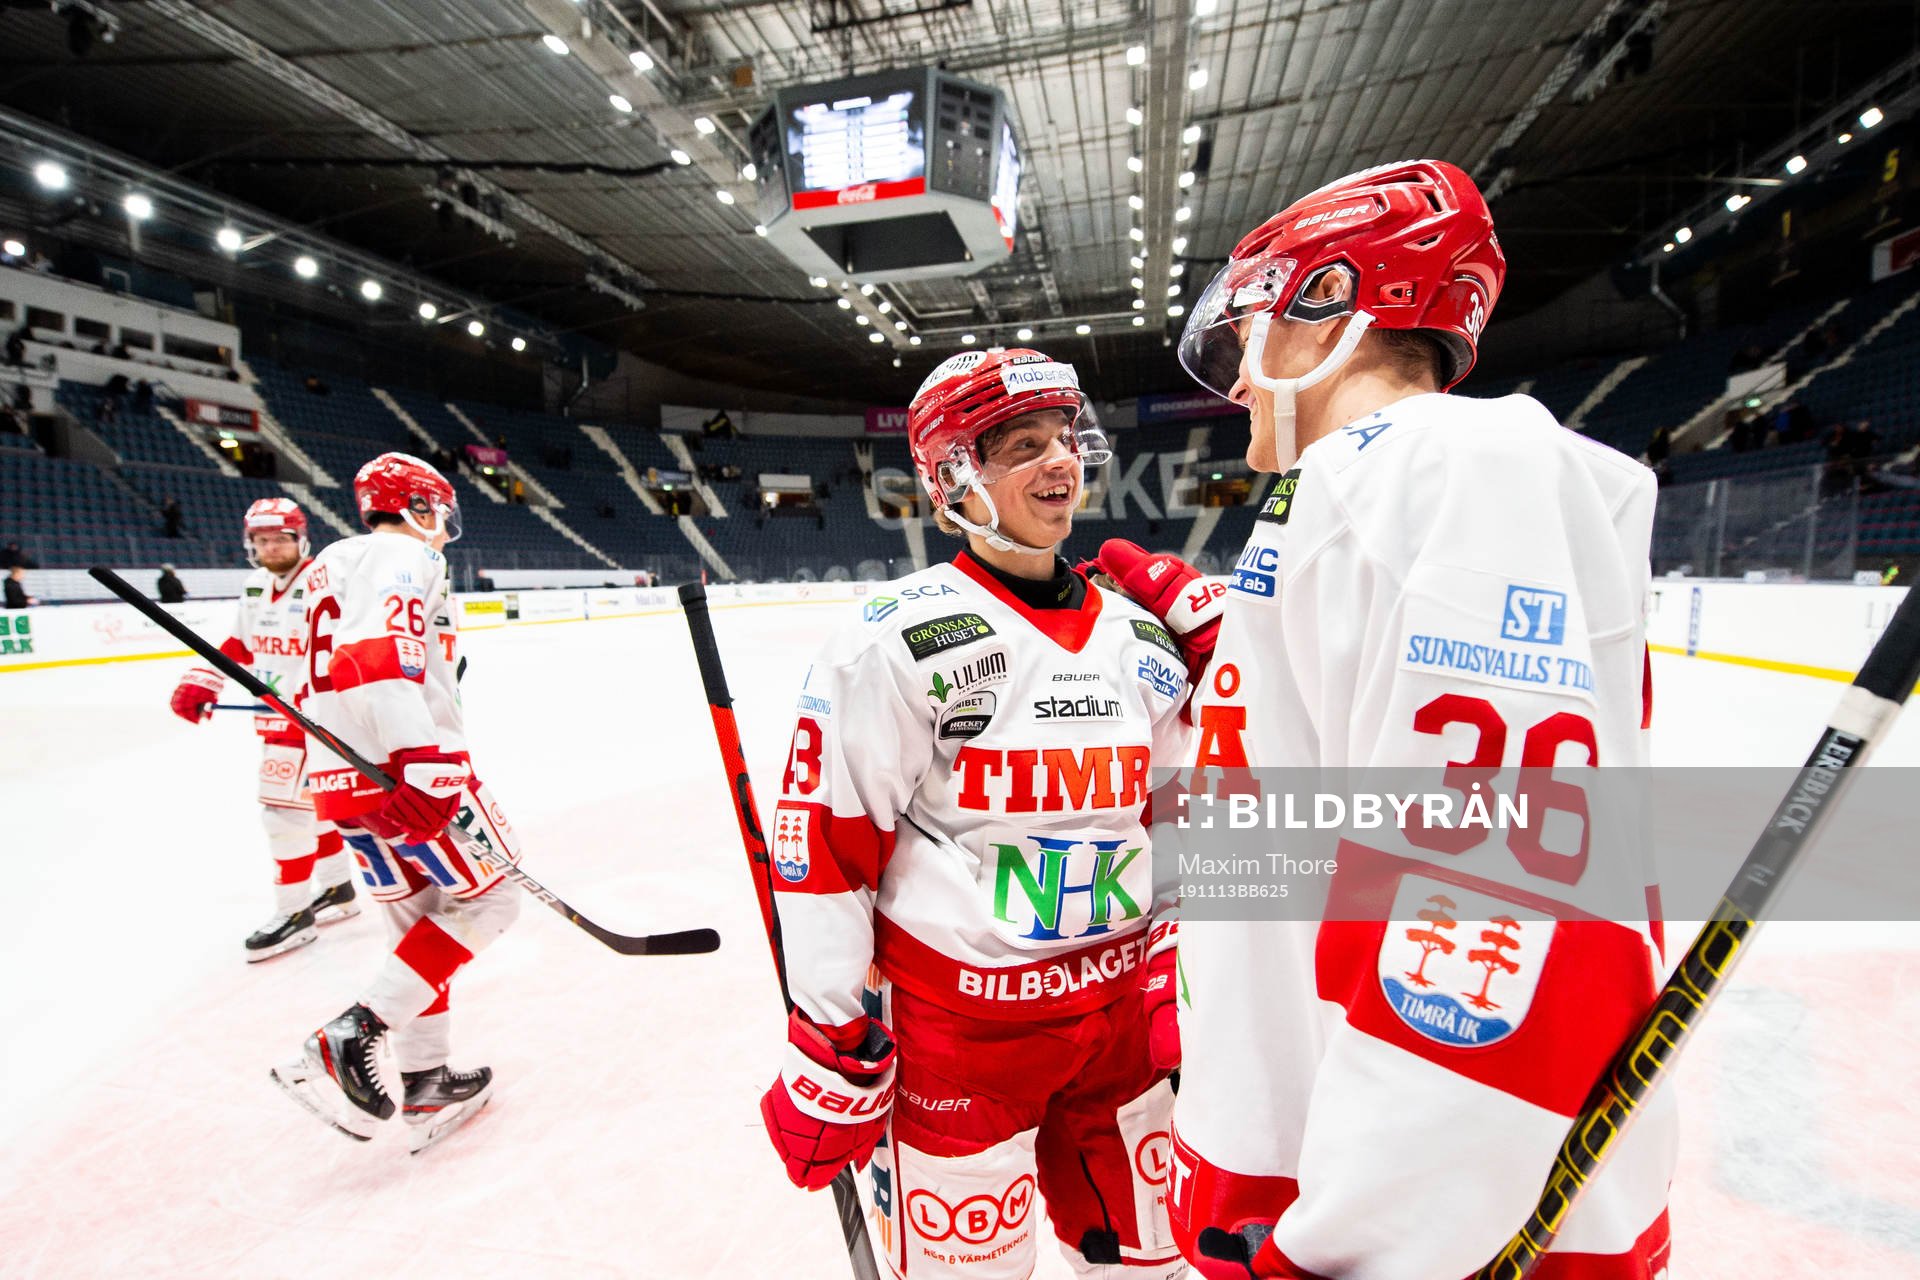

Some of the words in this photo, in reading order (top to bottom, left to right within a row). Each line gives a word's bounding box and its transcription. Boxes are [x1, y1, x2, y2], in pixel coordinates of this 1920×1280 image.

[1294, 203, 1370, 231] BAUER
[876, 412, 909, 428] LIV
[901, 583, 960, 600] SCA
[1246, 577, 1267, 593] ab
[384, 594, 425, 637] 26
[909, 615, 982, 644] GRÖNSAKS
[1503, 588, 1565, 641] ST
[934, 625, 977, 648] HUSET
[952, 651, 1007, 690] LILIUM
[1052, 673, 1100, 682] BAUER
[1407, 634, 1551, 685] SUNDSVALLS
[1033, 694, 1124, 719] stadium
[951, 720, 986, 731] HOCKEY
[952, 745, 1151, 814] TIMR
[1394, 692, 1601, 887] 36
[989, 835, 1144, 941] NHK
[958, 936, 1149, 1001] BILBOLAGET
[1400, 994, 1459, 1035] TIMRÅ
[1458, 1021, 1482, 1043] IK
[918, 1184, 1030, 1237] LBM
[948, 1253, 956, 1264] &
[958, 1231, 1029, 1264] VÄRMETEKNIK
